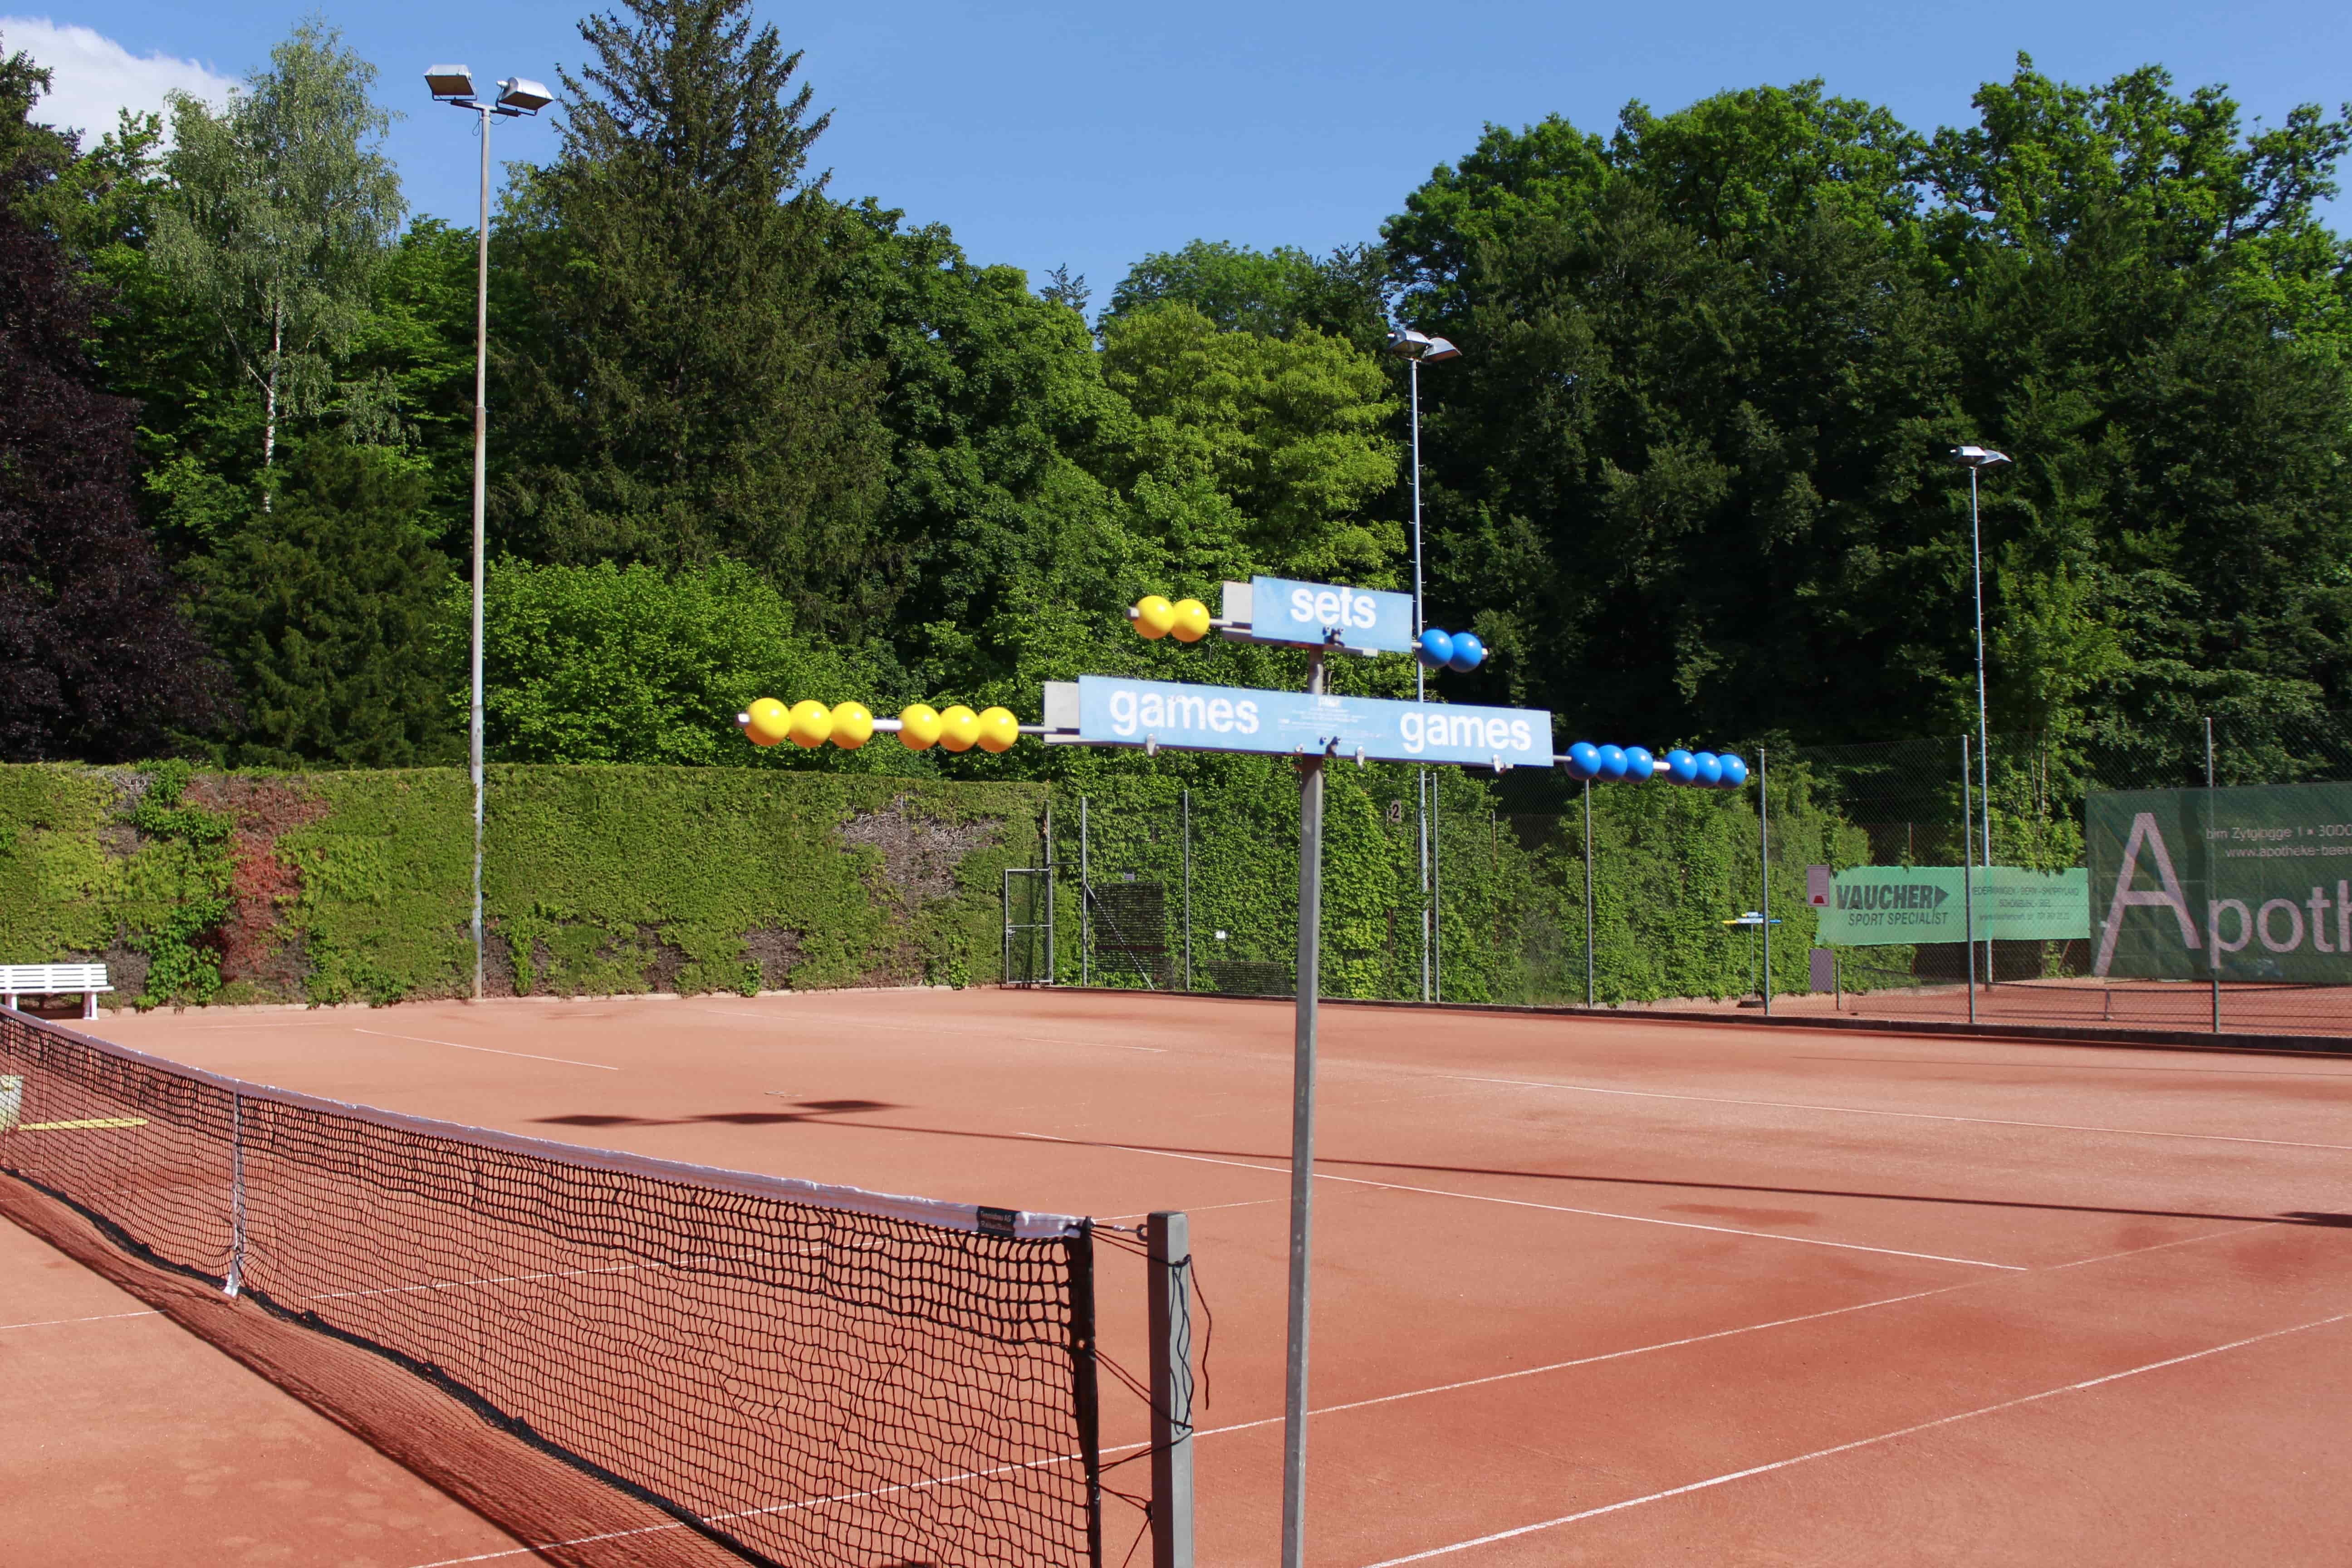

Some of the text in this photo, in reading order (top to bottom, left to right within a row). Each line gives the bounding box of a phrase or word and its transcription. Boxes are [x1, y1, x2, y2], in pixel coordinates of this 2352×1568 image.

[1290, 587, 1376, 629] sets
[1110, 690, 1259, 736] games
[1401, 712, 1531, 753] games
[1392, 804, 1399, 818] 2
[2206, 827, 2228, 839] bim
[2232, 827, 2292, 841] Zytglogge
[1837, 884, 1933, 910] VAUCHER
[1848, 912, 1949, 926] SPORT SPECIALIST
